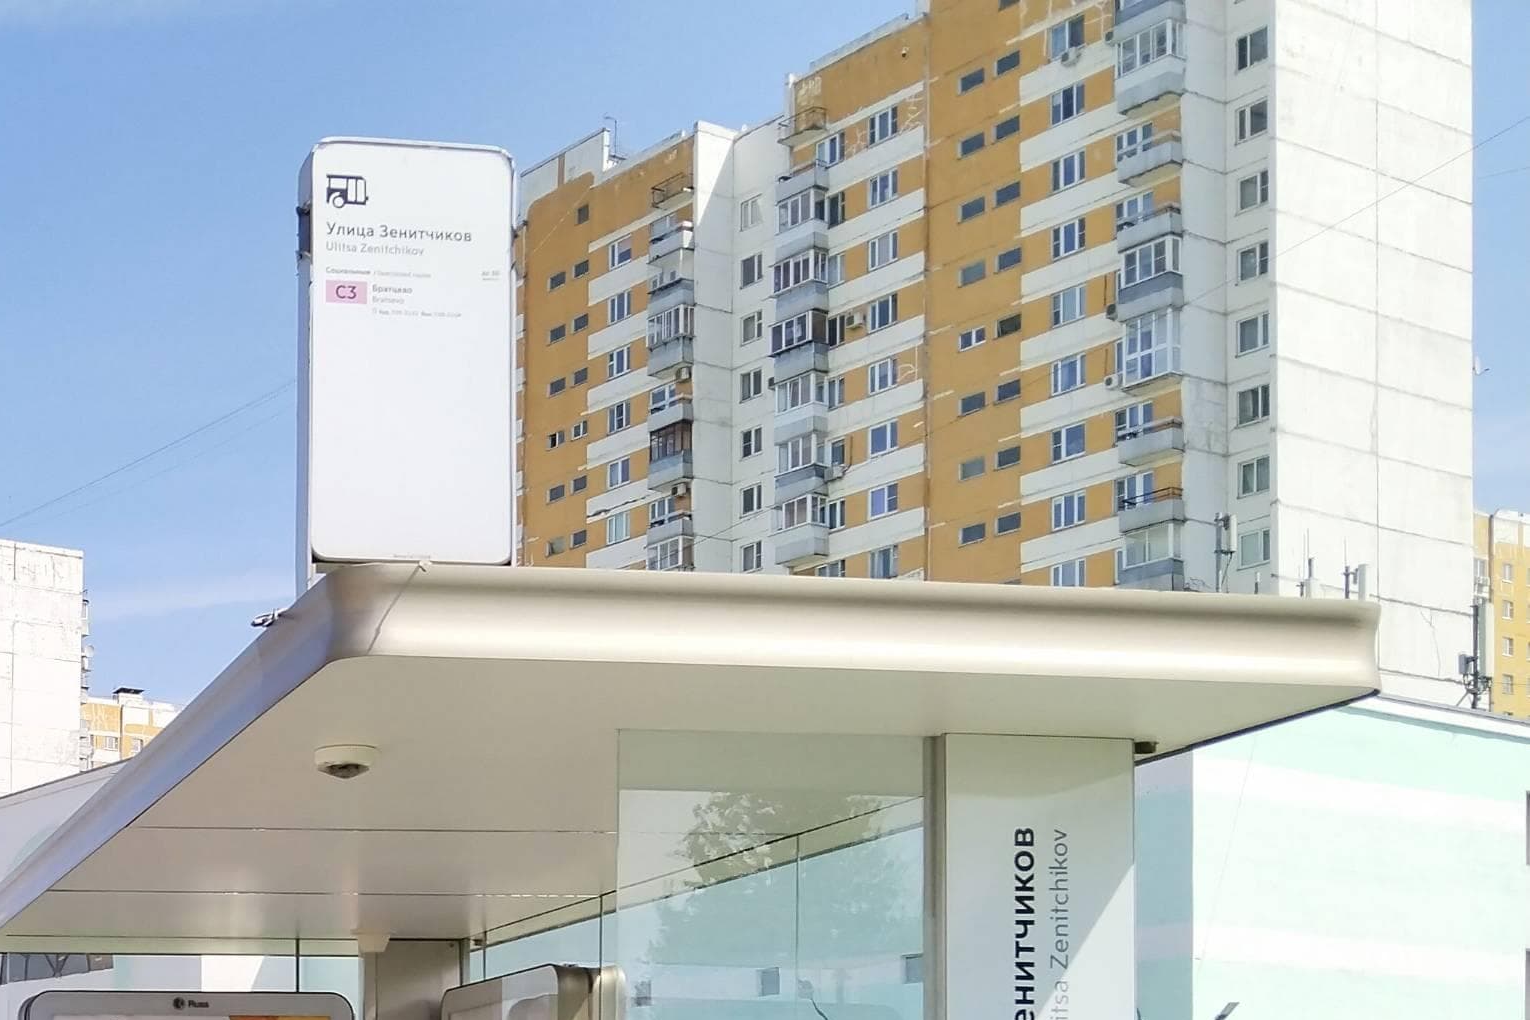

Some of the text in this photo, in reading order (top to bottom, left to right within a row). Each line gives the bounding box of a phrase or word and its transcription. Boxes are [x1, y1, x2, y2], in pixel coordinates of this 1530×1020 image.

[326, 221, 472, 242] Улица Зенитчиков
[326, 241, 424, 256] Ulitsa Zenitchikov
[1048, 828, 1069, 970] Zenitchikov
